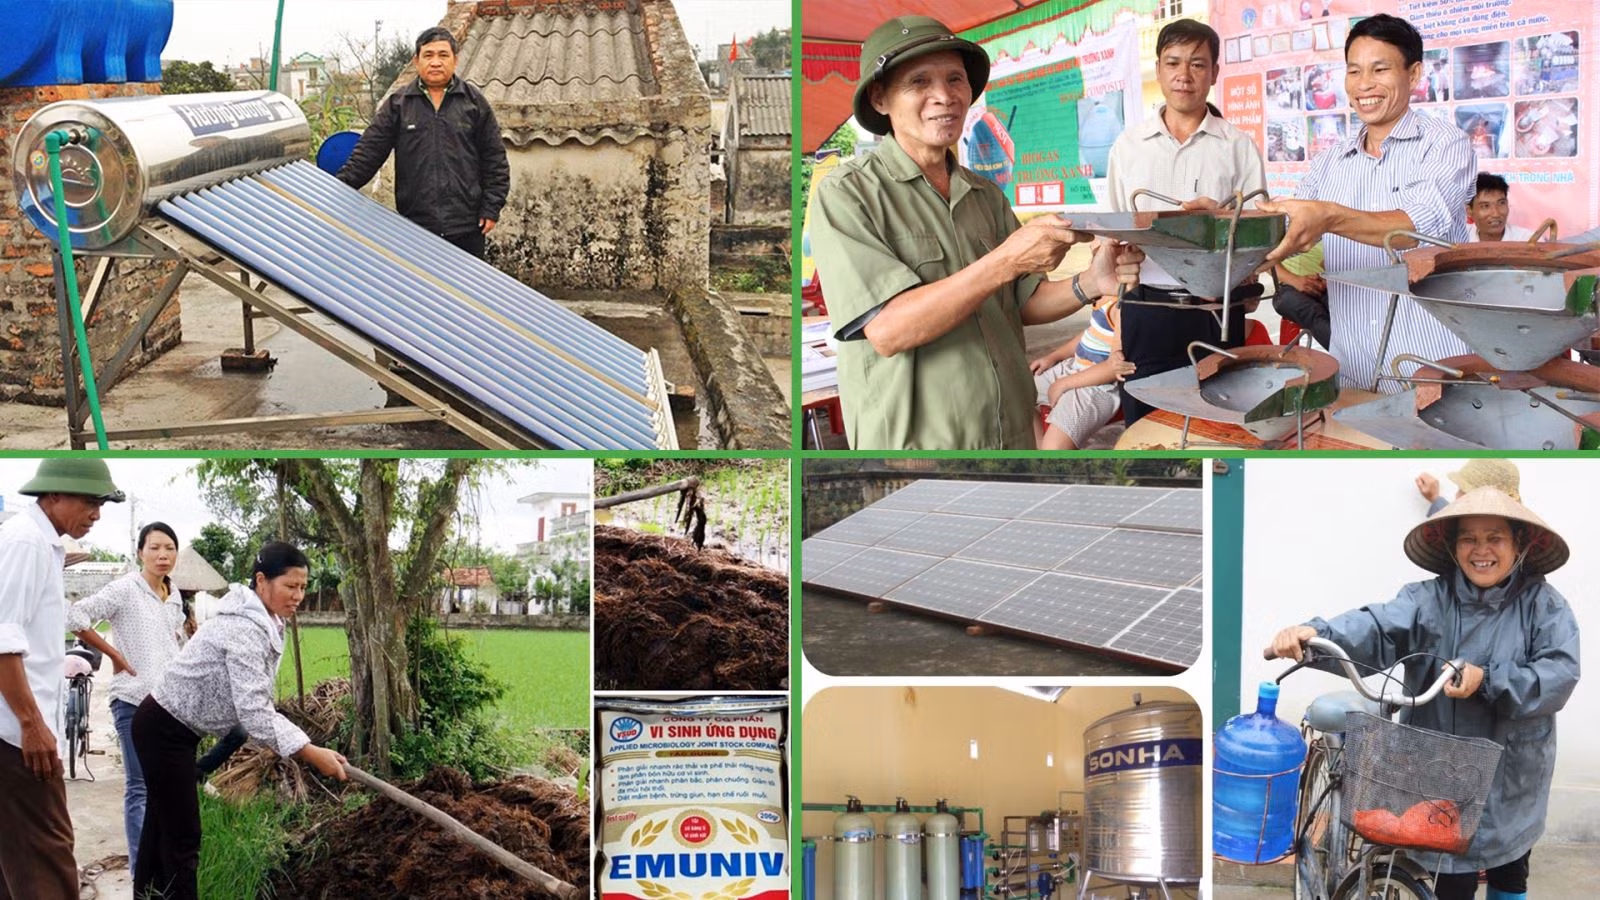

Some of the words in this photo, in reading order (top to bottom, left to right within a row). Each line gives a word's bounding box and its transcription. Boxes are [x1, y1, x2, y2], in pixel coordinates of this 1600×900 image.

[1022, 150, 1059, 165] BIOGAS
[650, 726, 663, 738] VI
[668, 726, 702, 738] SINH
[706, 722, 736, 738] ỨNG
[740, 726, 776, 740] DỤNG
[610, 744, 638, 752] APPLIED
[746, 742, 778, 750] COMPAN
[1089, 744, 1184, 772] SONHA
[609, 852, 784, 880] EMUNIV
